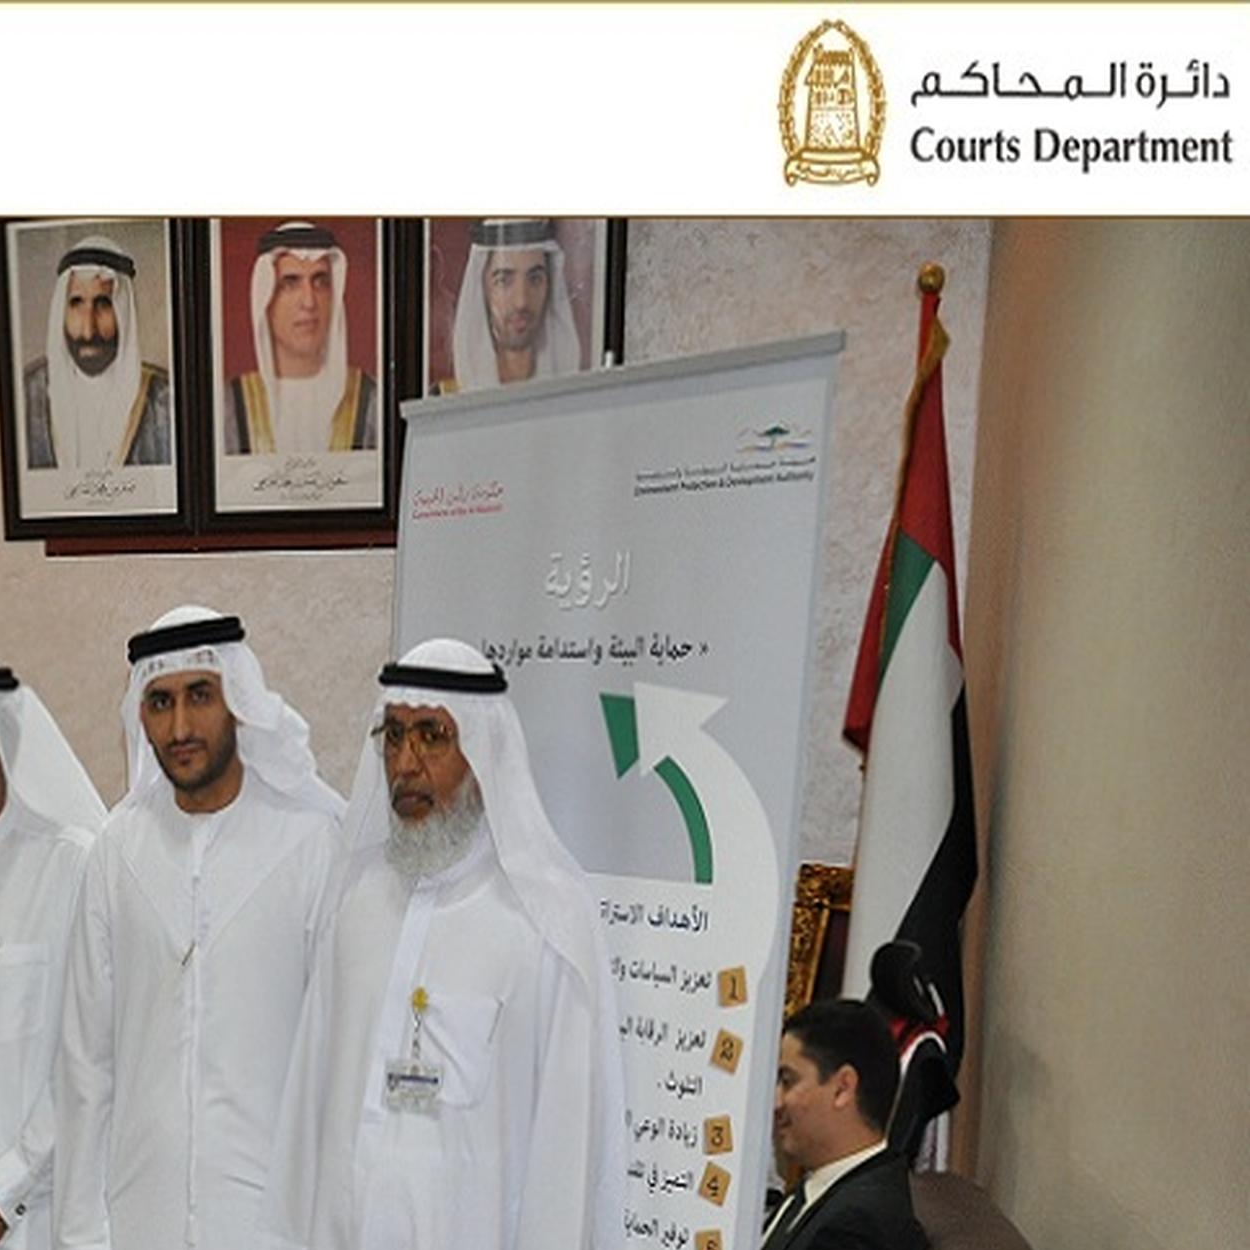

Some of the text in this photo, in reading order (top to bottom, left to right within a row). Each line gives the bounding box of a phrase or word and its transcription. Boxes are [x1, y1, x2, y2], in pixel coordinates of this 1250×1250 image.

[545, 551, 632, 612] الرؤية
[537, 634, 602, 666] واستدامة
[609, 633, 644, 666] البيئة
[649, 633, 692, 666] حماية
[648, 904, 709, 932] الأهداف
[630, 960, 678, 988] السياسات
[680, 970, 711, 994] تعزيز
[674, 1028, 706, 1052] تعزيز
